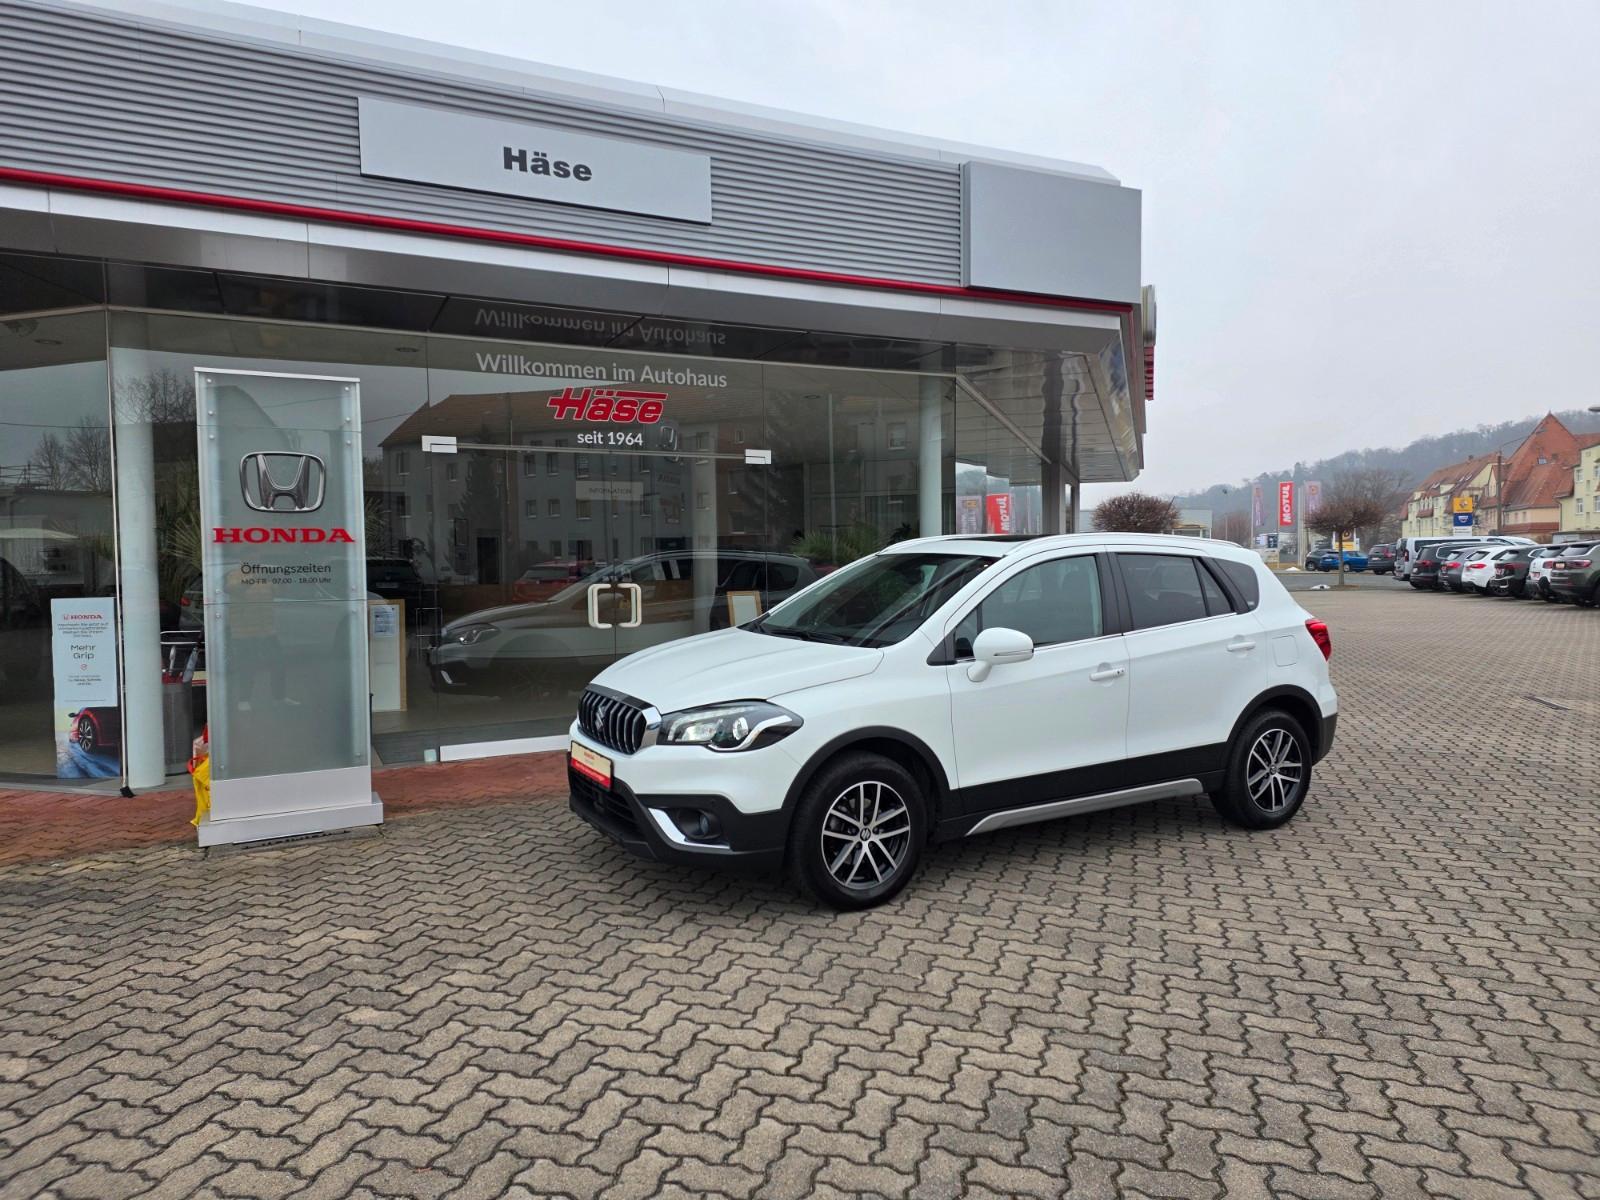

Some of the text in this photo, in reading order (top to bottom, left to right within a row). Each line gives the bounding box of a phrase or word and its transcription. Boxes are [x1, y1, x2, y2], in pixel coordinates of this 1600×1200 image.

[503, 146, 593, 182] Häse
[475, 352, 728, 388] Willkommen im Autohaus
[547, 387, 668, 424] Häse
[577, 431, 643, 446] seit 1964
[1282, 484, 1292, 523] MOTUL
[212, 527, 356, 544] HONDA
[240, 562, 332, 576] Öffnungszeiten
[73, 652, 95, 660] Grip
